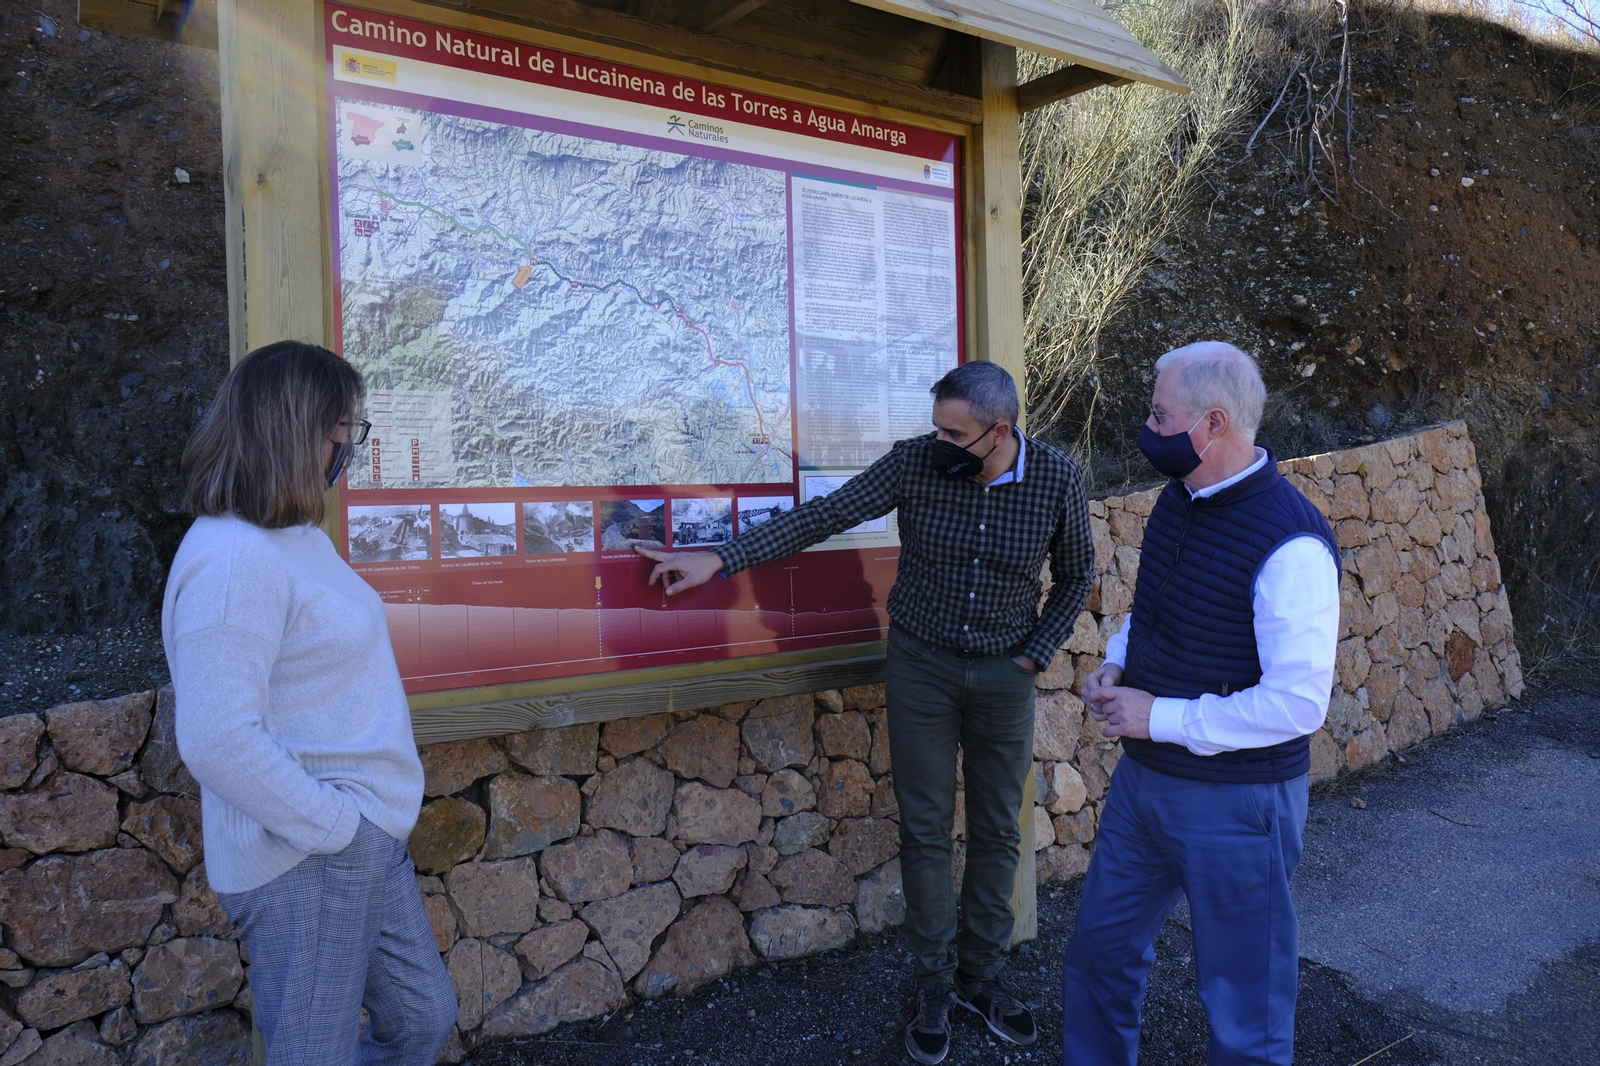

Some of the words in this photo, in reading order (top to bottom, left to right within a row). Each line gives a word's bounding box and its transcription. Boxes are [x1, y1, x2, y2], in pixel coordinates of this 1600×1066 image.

[331, 10, 427, 48] Camino
[435, 30, 521, 68] Natural
[528, 51, 555, 74] de
[562, 57, 666, 97] Lucainena
[672, 81, 696, 102] de
[702, 85, 726, 108] las
[730, 92, 788, 121] Torres
[792, 109, 802, 124] a
[807, 109, 846, 133] Agua
[850, 118, 907, 147] Amarga
[688, 119, 724, 134] Caminos
[688, 128, 729, 144] Naturales
